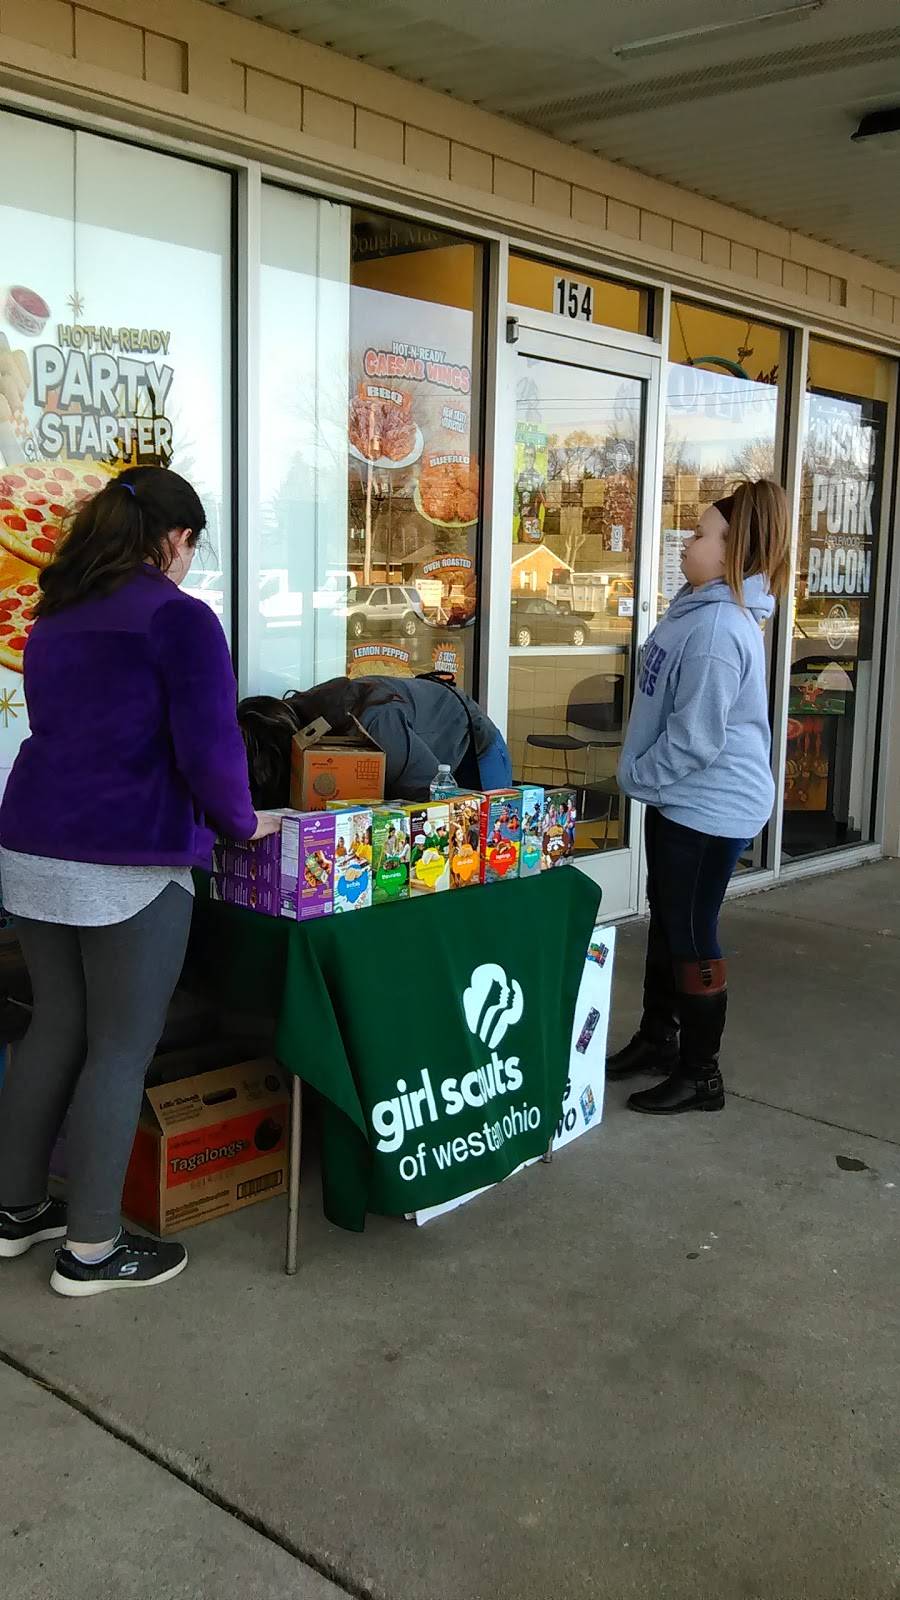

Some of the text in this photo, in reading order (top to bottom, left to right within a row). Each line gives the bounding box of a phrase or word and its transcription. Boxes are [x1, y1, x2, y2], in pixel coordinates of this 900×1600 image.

[557, 278, 592, 321] 154
[57, 323, 170, 356] HOT-N-READY
[34, 344, 174, 416] PARTY
[364, 348, 470, 393] CAESAR WINGS
[367, 385, 403, 405] BBQ
[40, 411, 174, 464] STARTER
[430, 455, 470, 467] BUFFALO
[811, 473, 875, 535] PORK
[423, 557, 472, 574] OVEN ROASTED
[808, 547, 872, 594] BACON
[353, 646, 409, 662] LEMON PEPPER
[371, 1068, 439, 1152] girl
[169, 1139, 244, 1173] Tagalongs
[399, 1142, 427, 1181] of
[503, 1101, 541, 1139] ohio
